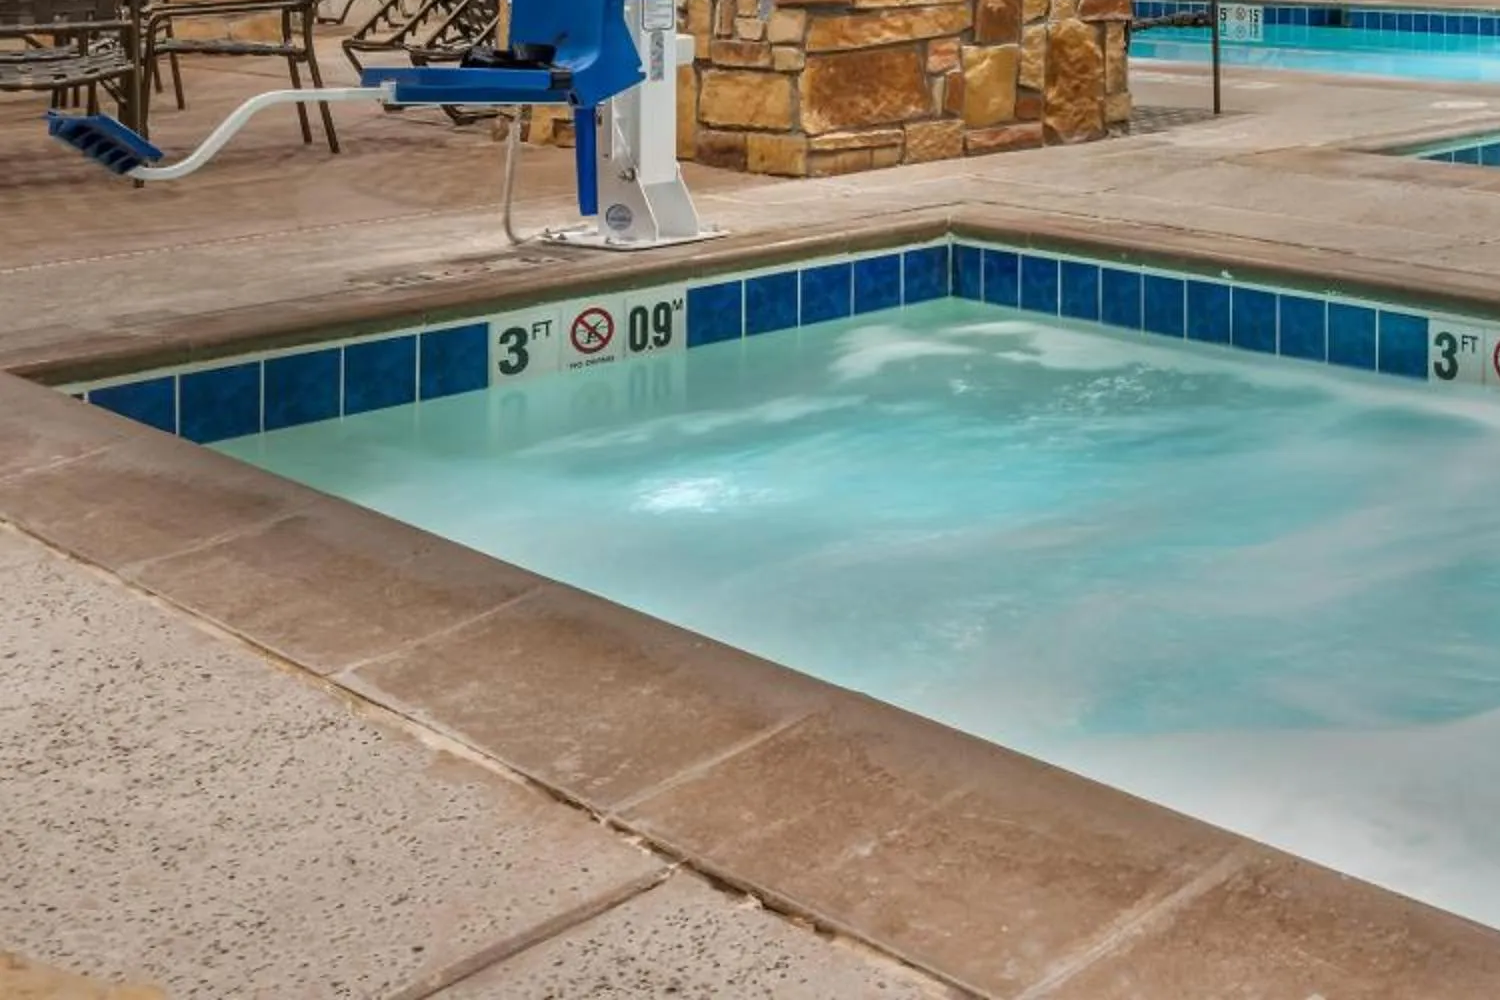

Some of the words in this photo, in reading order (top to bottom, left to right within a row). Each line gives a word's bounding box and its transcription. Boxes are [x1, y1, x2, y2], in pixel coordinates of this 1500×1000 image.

[1220, 8, 1227, 21] 5
[498, 326, 529, 376] 3
[531, 319, 553, 340] FT
[1433, 331, 1459, 381] 3
[1461, 335, 1478, 353] FT
